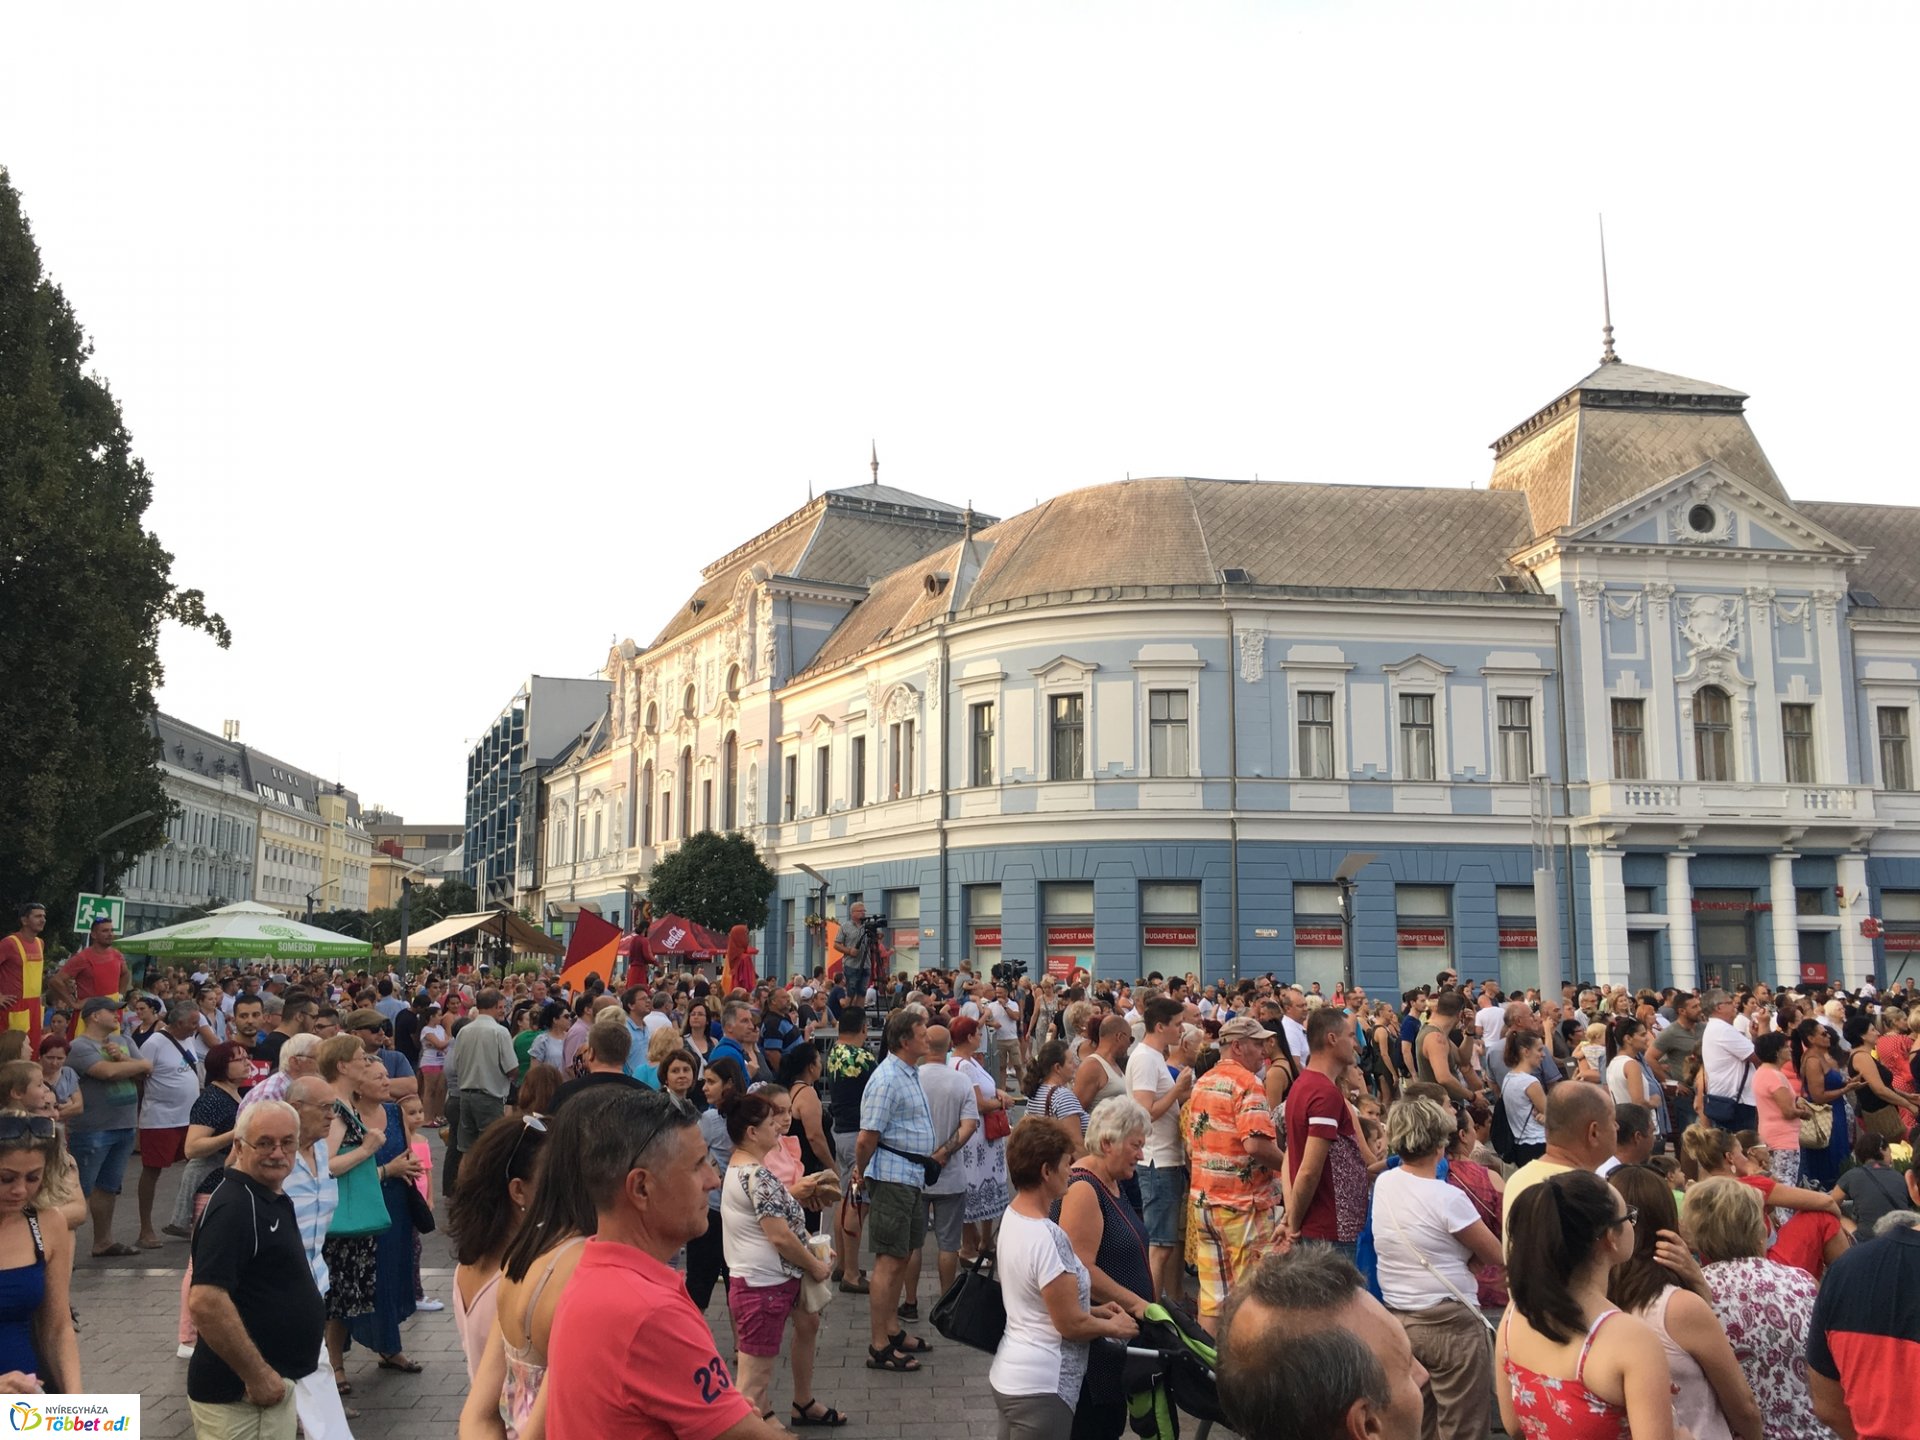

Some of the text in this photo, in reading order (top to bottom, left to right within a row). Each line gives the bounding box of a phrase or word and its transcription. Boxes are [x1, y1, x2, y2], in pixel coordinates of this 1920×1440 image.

[277, 941, 317, 953] SOMERSBY
[29, 1217, 44, 1251] SUPERIOR
[694, 1357, 729, 1404] 23
